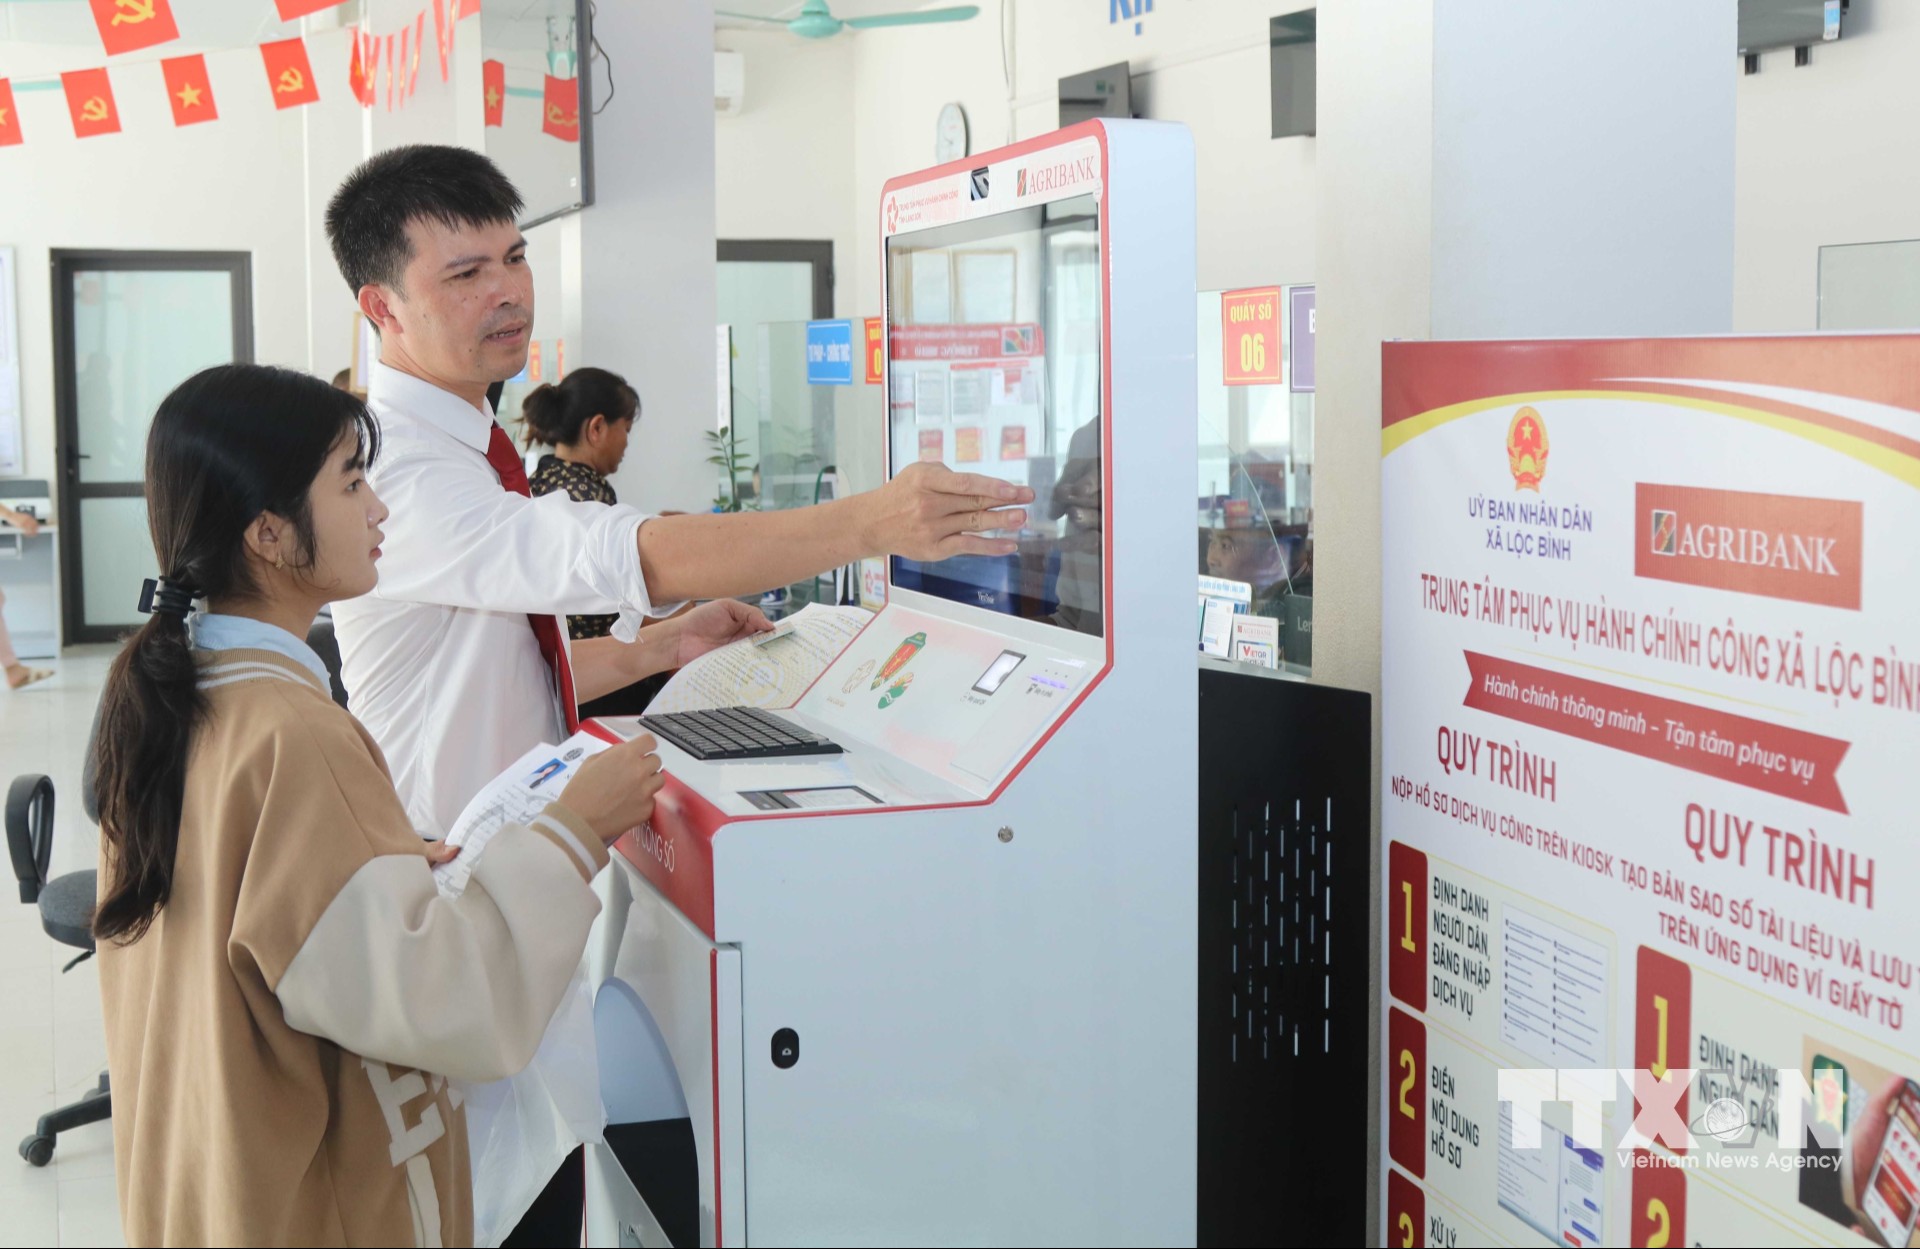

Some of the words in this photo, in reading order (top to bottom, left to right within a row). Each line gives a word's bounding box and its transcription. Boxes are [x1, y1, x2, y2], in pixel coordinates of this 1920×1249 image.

[1028, 155, 1095, 195] AGRIBANK
[1258, 296, 1272, 321] SỐ
[873, 347, 882, 376] 0
[1240, 332, 1265, 373] 06
[1488, 499, 1516, 523] BAN
[1519, 499, 1558, 528] NHÂN
[1562, 503, 1592, 532] DÂN
[1486, 525, 1503, 551] XÃ
[1507, 529, 1534, 559] LỘC
[1538, 531, 1571, 561] BÌNH
[1678, 522, 1840, 576] AGRIBANK
[1421, 573, 1469, 618] TRUNG
[1473, 575, 1505, 626] TÂM
[1510, 590, 1553, 642] PHỤC
[1557, 598, 1580, 651] VỤ
[1586, 595, 1635, 653] HÀNH
[1641, 607, 1701, 667] CHÍNH
[1708, 617, 1769, 681] CÔNG
[1776, 630, 1806, 690] XÃ
[1815, 641, 1864, 709] LỘC
[1484, 673, 1519, 700] Hành
[1521, 683, 1559, 711] chính
[1562, 695, 1605, 728] thông
[1608, 709, 1646, 735] minh
[1665, 719, 1696, 750] Tận
[1699, 729, 1735, 759] tâm
[1736, 741, 1787, 775] phục
[1790, 757, 1815, 786] vụ
[1438, 725, 1481, 776] QUY
[1486, 739, 1557, 803] TRÌNH
[641, 820, 663, 863] CÔNG
[664, 837, 675, 873] SỐ
[1392, 775, 1413, 802] NỘP
[1433, 791, 1449, 814] SƠ
[1451, 797, 1478, 826] DỊCH
[1481, 807, 1497, 838] VỤ
[1500, 815, 1533, 847] CÔNG
[1536, 828, 1568, 860] TRÊN
[1572, 841, 1614, 878] KIOSK
[1685, 802, 1754, 868] QUY
[1762, 826, 1875, 911] TRÌNH
[1401, 880, 1416, 954] 1
[1433, 876, 1458, 908] ĐỊNH
[1461, 888, 1489, 922] DANH
[1620, 859, 1648, 891] TẠO
[1653, 870, 1684, 905] BẢN
[1690, 885, 1723, 918] SAO
[1729, 898, 1754, 930] SỐ
[1758, 907, 1784, 942] TÀI
[1790, 923, 1833, 961] LIỆU
[1839, 938, 1864, 974] VÀ
[1870, 949, 1912, 990] LƯU
[1433, 910, 1465, 945] NGƯỜI
[1467, 924, 1490, 962] DÂN,
[1433, 942, 1460, 976] ĐĂNG
[1463, 957, 1491, 993] NHẬP
[1658, 911, 1699, 950] TRÊN
[1705, 926, 1741, 965] ỨNG
[1747, 945, 1799, 989] DỤNG
[1804, 967, 1823, 999] VÍ
[1829, 978, 1873, 1019] GIẤY
[1877, 996, 1904, 1031] TỜ
[1433, 975, 1457, 1010] DỊCH
[1459, 988, 1474, 1021] VỤ
[1652, 995, 1673, 1084] 1
[1399, 1049, 1416, 1120] 2
[1432, 1097, 1448, 1130] NỘI
[1451, 1109, 1480, 1148] DUNG
[1448, 1141, 1462, 1170] SƠ
[1430, 1216, 1444, 1245] XỬ
